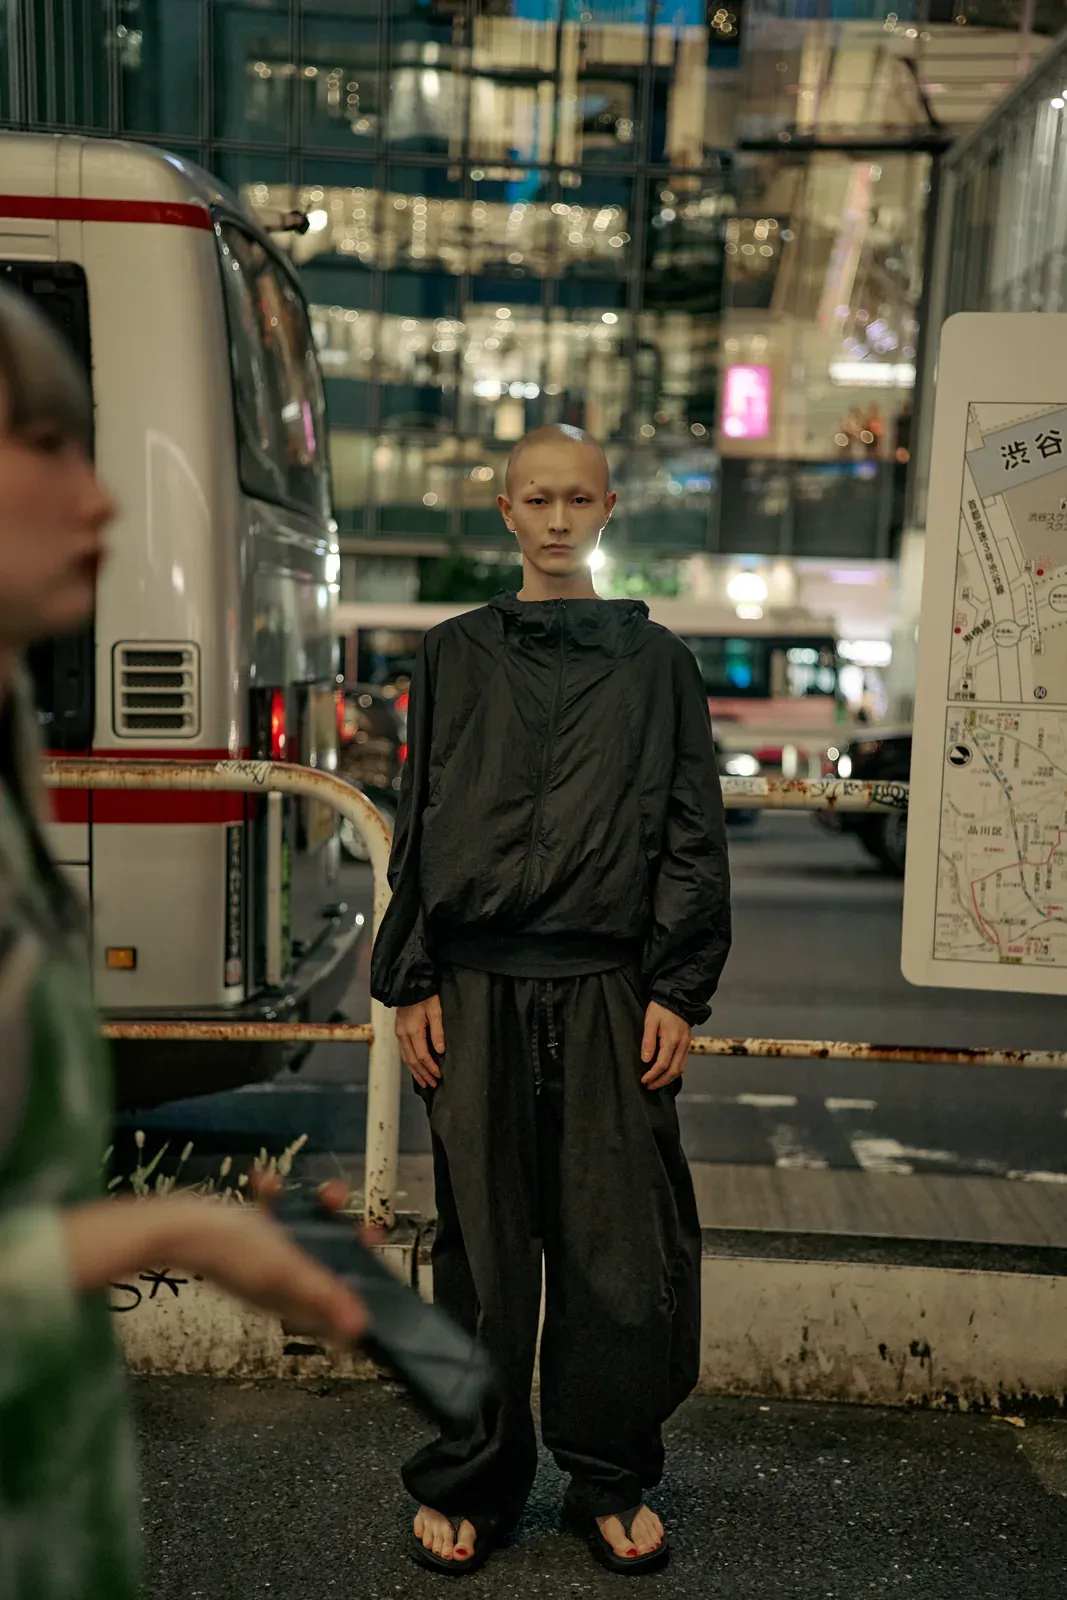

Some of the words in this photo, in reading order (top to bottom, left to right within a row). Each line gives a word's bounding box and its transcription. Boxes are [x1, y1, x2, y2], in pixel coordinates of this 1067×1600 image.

[1000, 429, 1063, 471] 渋谷
[967, 825, 1002, 836] 品川区
